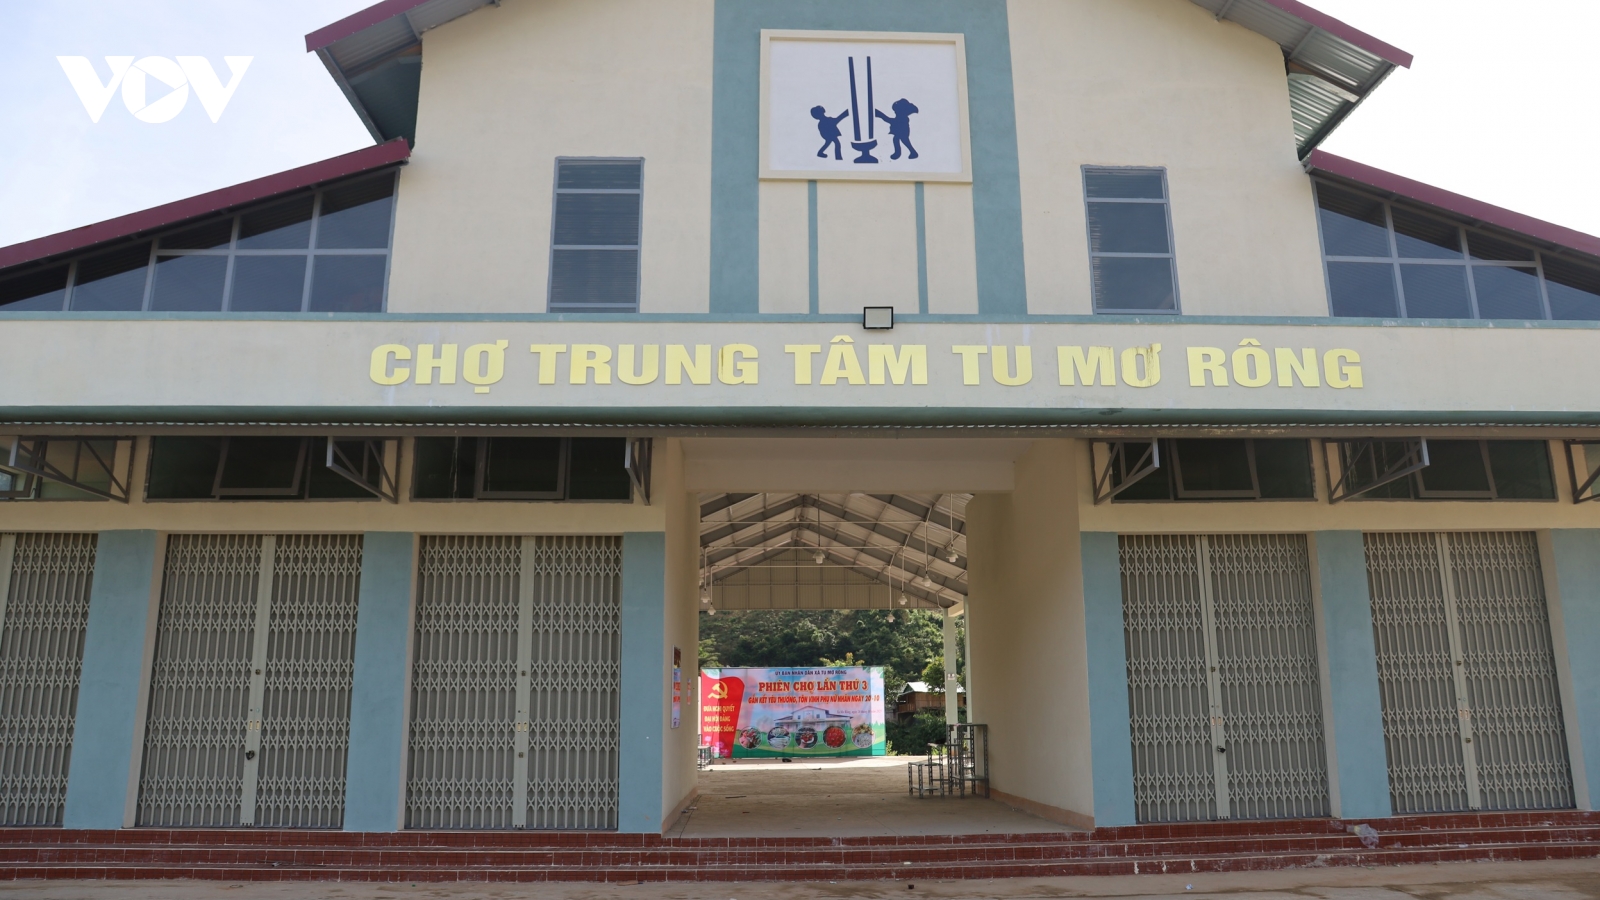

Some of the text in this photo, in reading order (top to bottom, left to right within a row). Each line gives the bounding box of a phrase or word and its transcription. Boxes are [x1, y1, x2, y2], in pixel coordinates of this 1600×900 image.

[369, 335, 1363, 393] CHỢ TRUNG TÂM TU MƠ RÔNG
[758, 680, 790, 692] PHIÊN
[793, 681, 814, 694] CHỢ
[862, 680, 868, 690] 3
